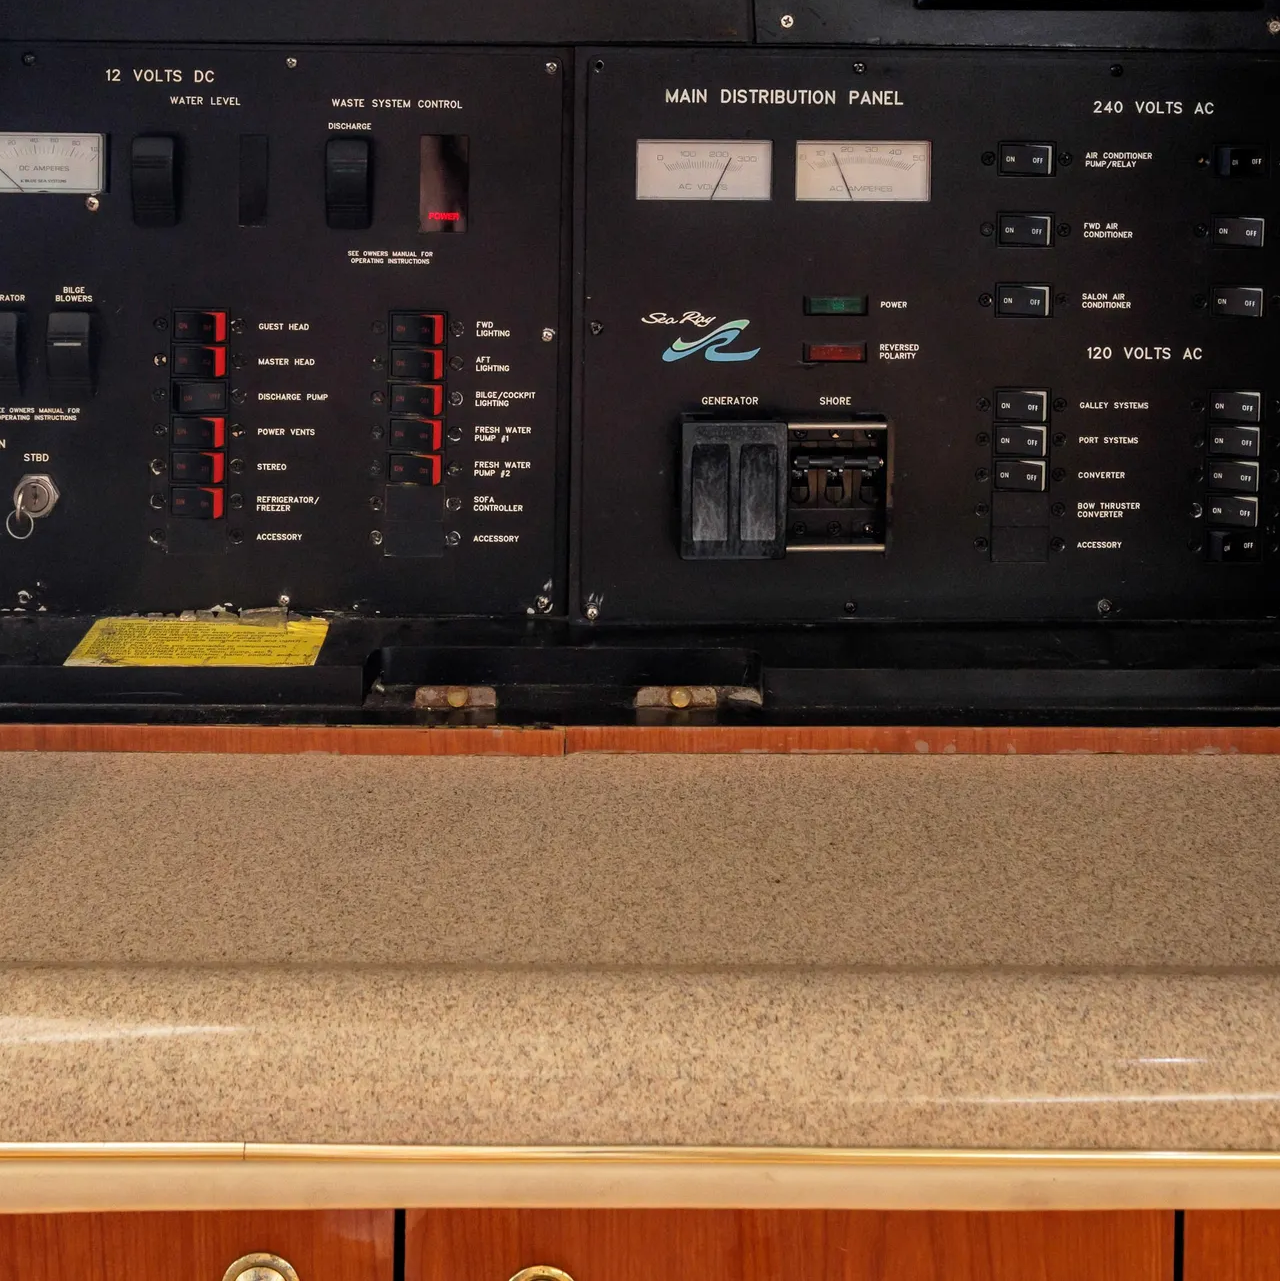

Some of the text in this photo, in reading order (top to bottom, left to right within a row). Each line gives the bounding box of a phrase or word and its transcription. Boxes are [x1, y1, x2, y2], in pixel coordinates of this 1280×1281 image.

[106, 69, 214, 82] 12 VOLTS DC
[169, 95, 241, 106] WATER LEVEL
[666, 89, 903, 105] MAIN DISTRIBUTION PANEL
[331, 98, 463, 109] WASTE SYSTEM CONTROL
[1094, 101, 1214, 114] 240 VOLTS AC
[328, 122, 372, 131] DISCHARGE
[1085, 151, 1153, 160] AIR CONDITIONER
[18, 164, 71, 173] DC AMPERES
[1085, 160, 1137, 169] PUMP/RELAY
[427, 211, 461, 222] POWER
[1083, 222, 1119, 230] FWD AIR
[1083, 230, 1134, 239] CONDITIONER
[62, 286, 86, 294] BILGE
[55, 294, 93, 303] BLOWERS
[1081, 292, 1126, 301] SALON AIR
[880, 300, 908, 309] POWER
[1081, 301, 1132, 309] CONDITIONER
[641, 310, 717, 328] Sea Ray
[258, 322, 310, 331] GUEST HEAD
[476, 320, 494, 329] FWD
[476, 329, 511, 338] LIGHTING
[879, 343, 920, 352] REVERSED
[879, 352, 917, 360] POLARITY
[1087, 347, 1202, 359] 120 VOLTS AC
[257, 357, 316, 366] MASTER HEAD
[475, 355, 491, 364] AFT
[475, 364, 510, 372] LIGHTING
[475, 390, 536, 400] BILGE/COCKPIT
[474, 399, 510, 408] LIGHTING
[701, 396, 759, 406] GENERATOR
[819, 396, 852, 406] SHORE
[1079, 401, 1149, 410] GALLEY SYSTEMS
[257, 427, 316, 436] POWER VENTS
[1078, 436, 1139, 445] PORT SYSTEMS
[23, 453, 50, 463] STBD
[256, 463, 287, 471] STEREO
[1077, 471, 1126, 479] CONVERTER
[256, 495, 320, 505] REFRIGERATOR/
[473, 495, 495, 504] SOFA
[256, 504, 291, 512] FREEZER
[473, 504, 524, 512] CONTROLLER
[256, 533, 303, 541] ACCESSORY
